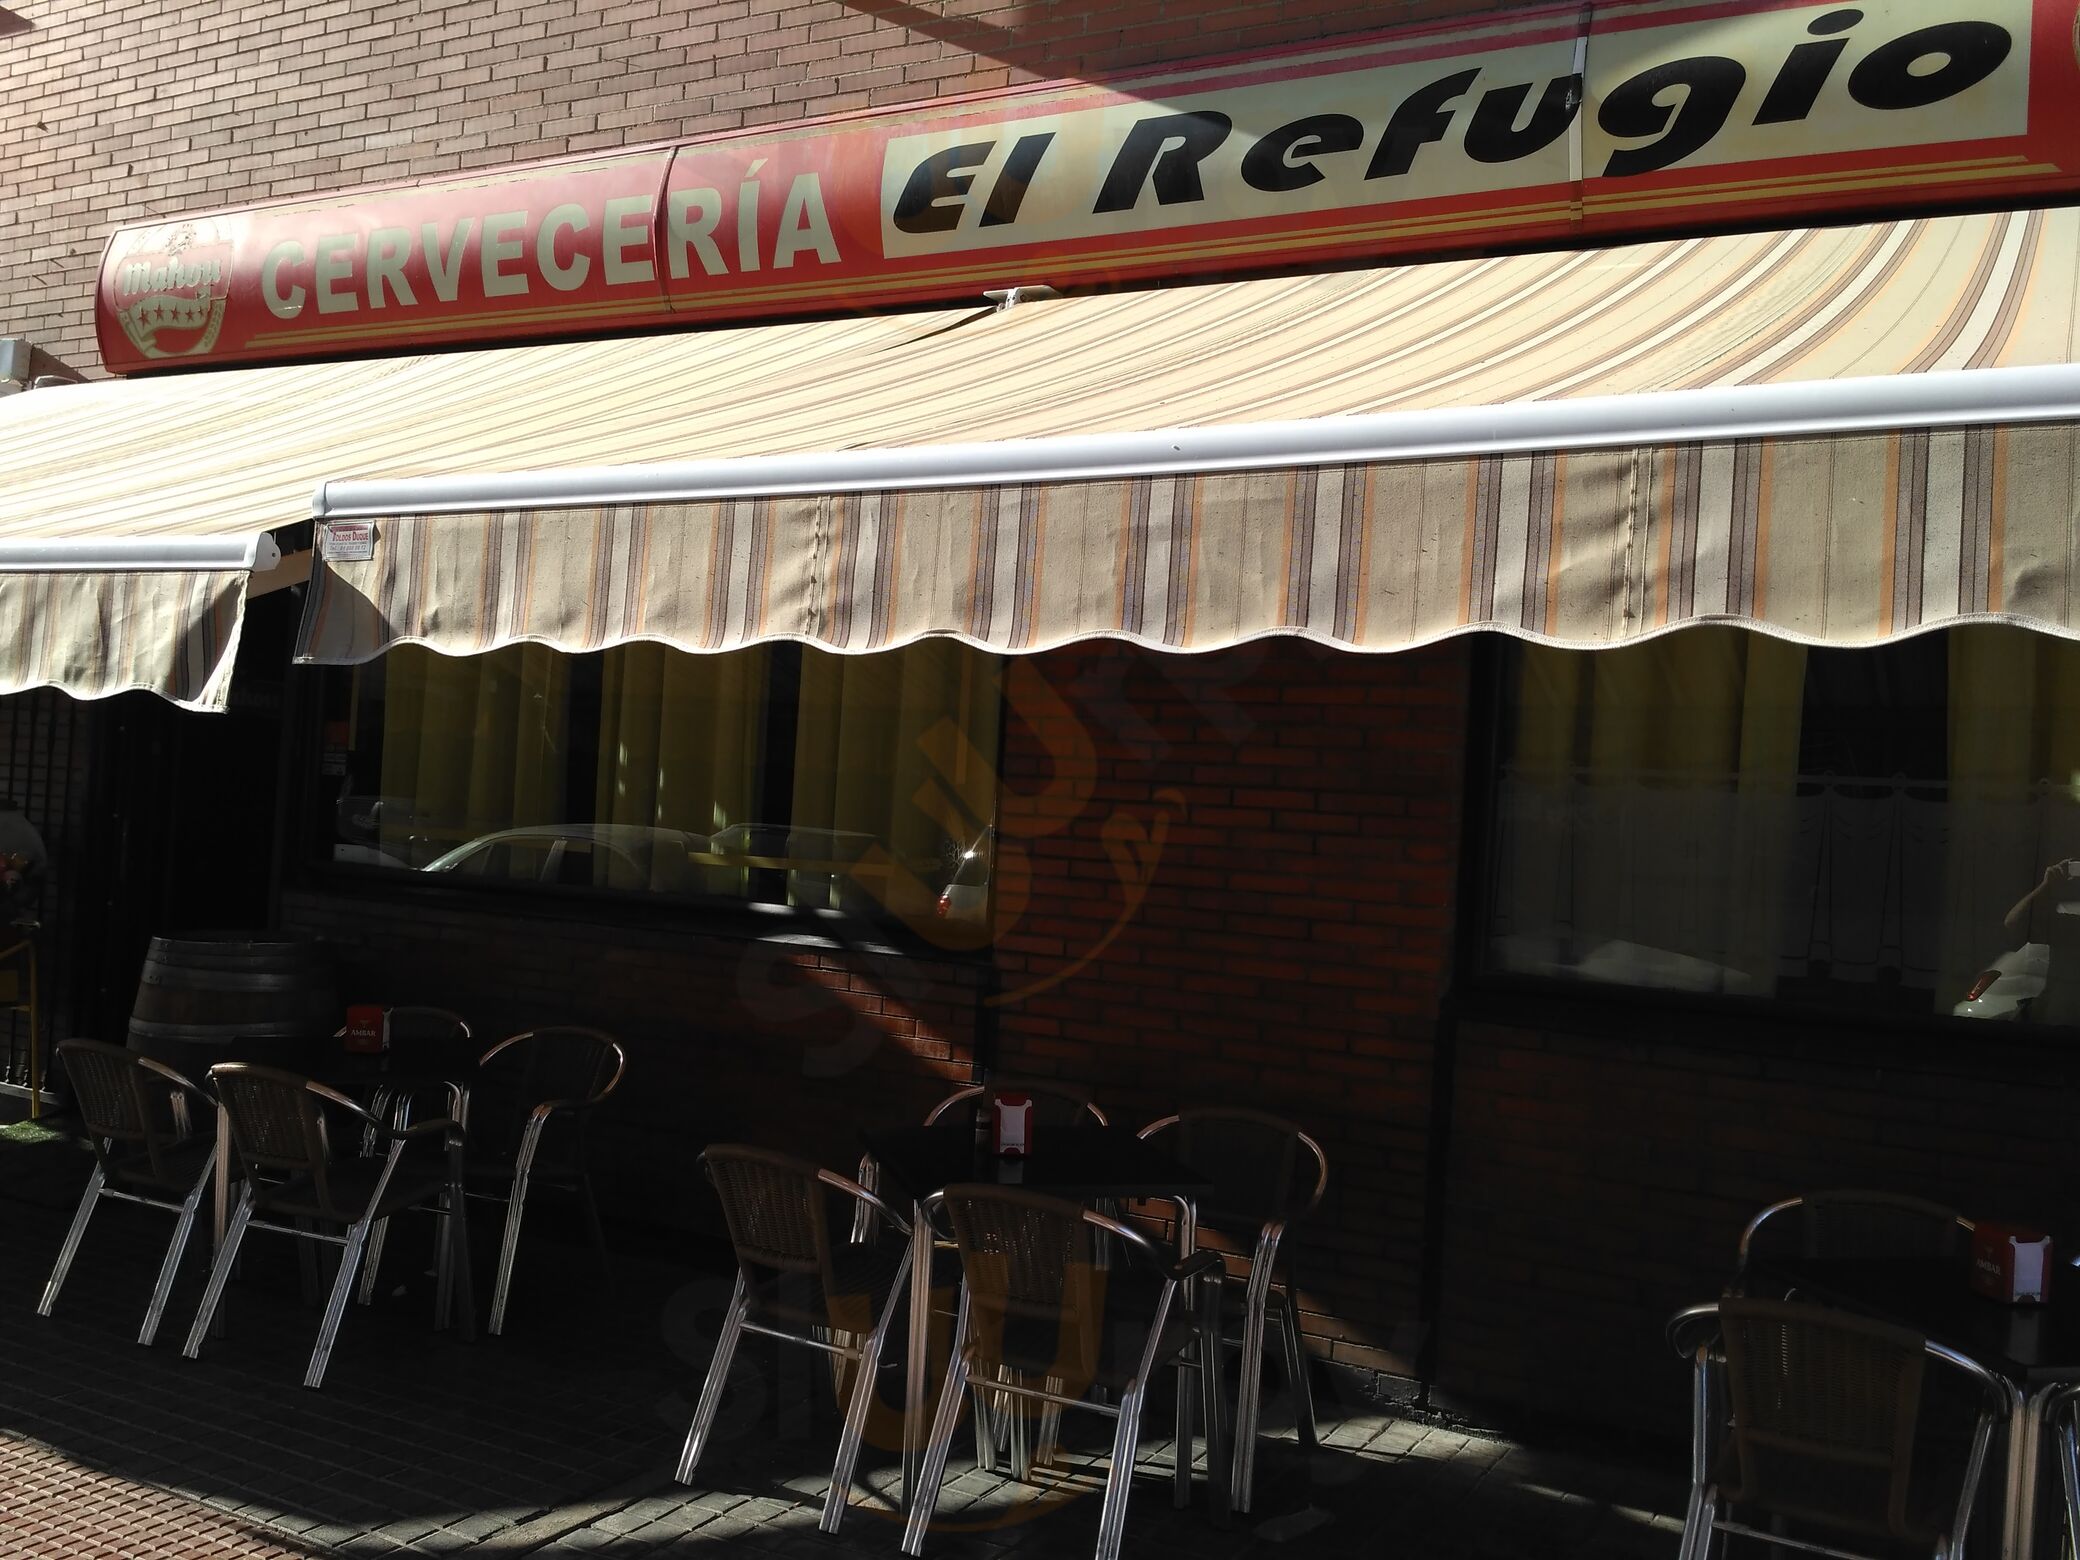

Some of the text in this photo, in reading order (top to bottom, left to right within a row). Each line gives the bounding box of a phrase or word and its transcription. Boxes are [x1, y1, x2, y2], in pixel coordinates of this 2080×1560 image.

[261, 157, 841, 320] CERVECERÍA
[892, 132, 1056, 234] El
[1092, 8, 2013, 214] Refugio
